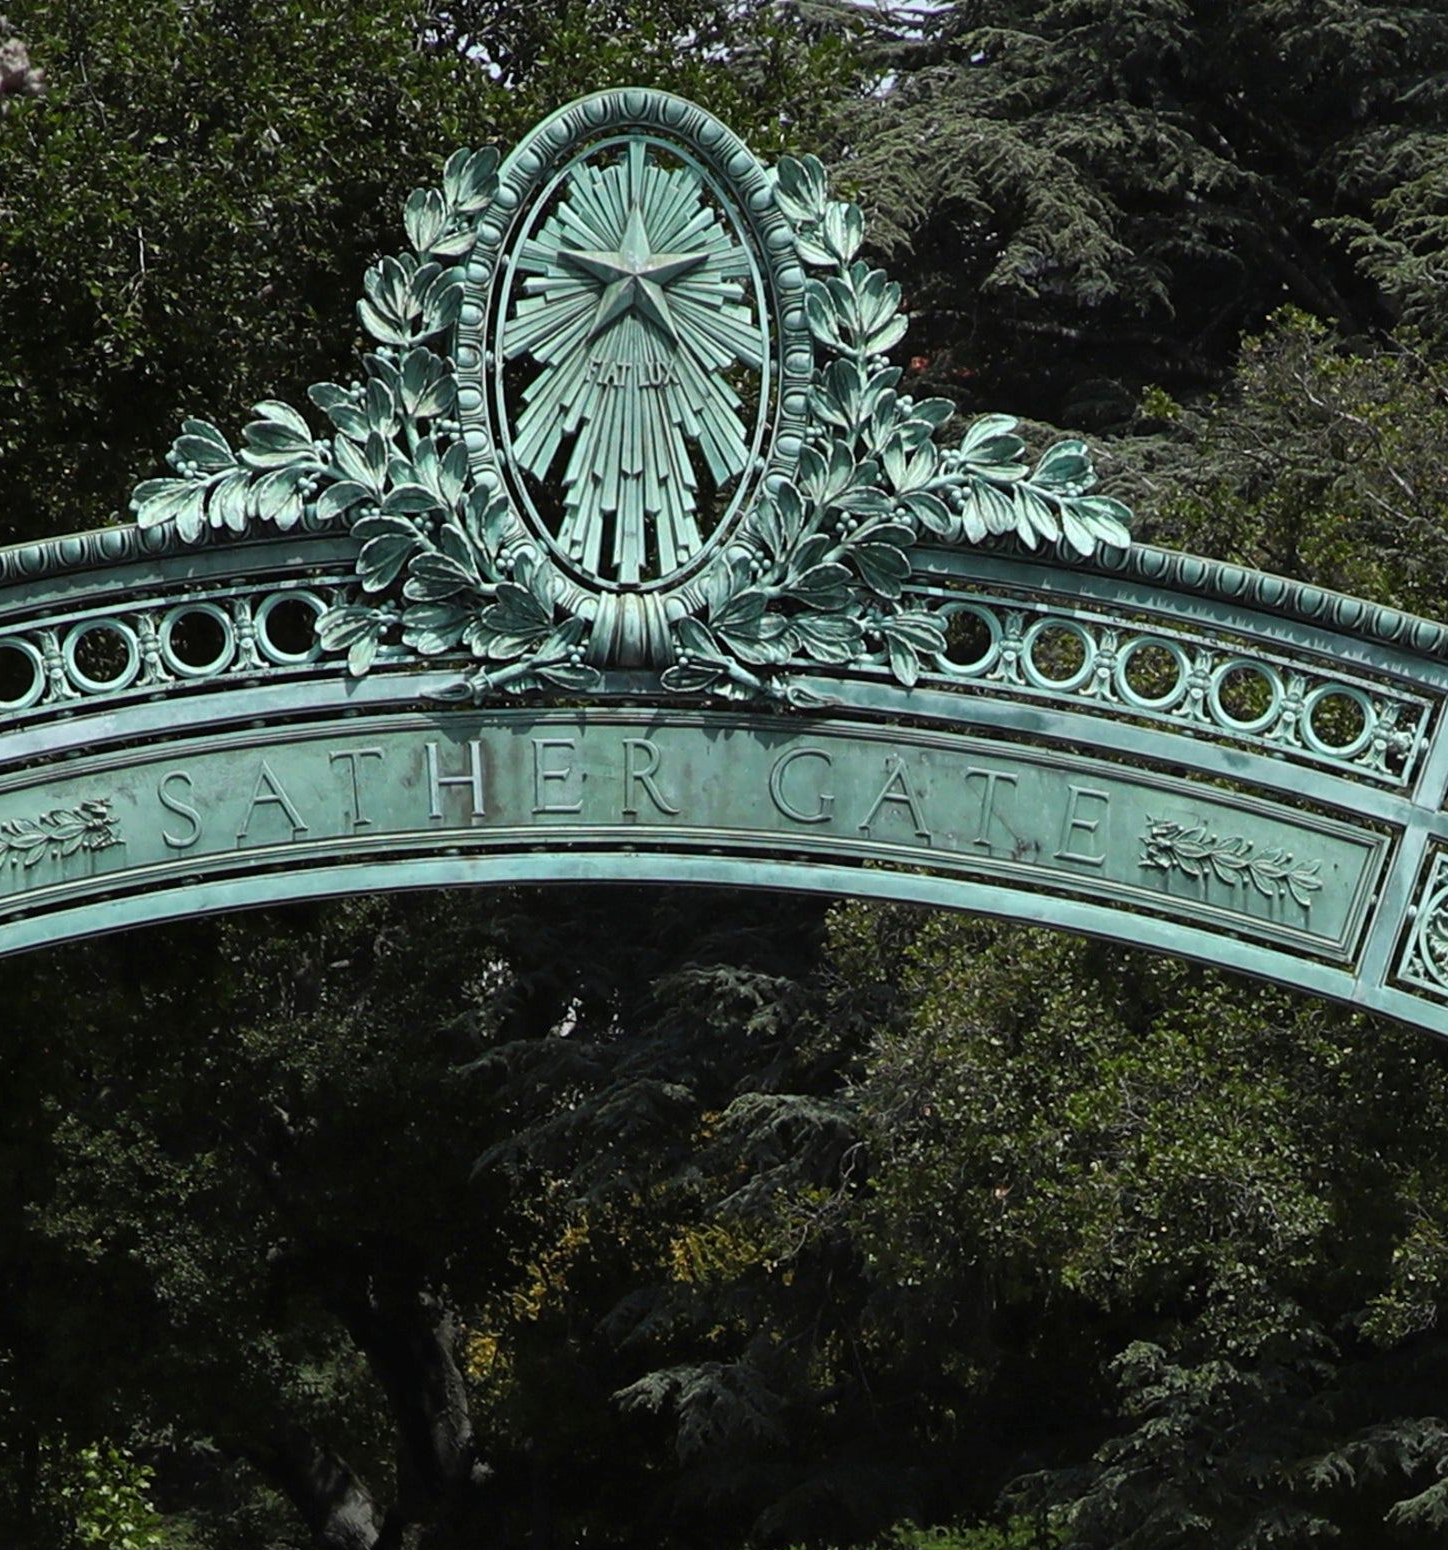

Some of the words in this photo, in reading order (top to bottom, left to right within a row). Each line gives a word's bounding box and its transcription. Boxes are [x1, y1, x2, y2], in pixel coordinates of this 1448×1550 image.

[585, 358, 632, 387] FIAT
[638, 360, 680, 388] LUX
[157, 738, 680, 848] SATHER
[768, 746, 1111, 866] GATE
